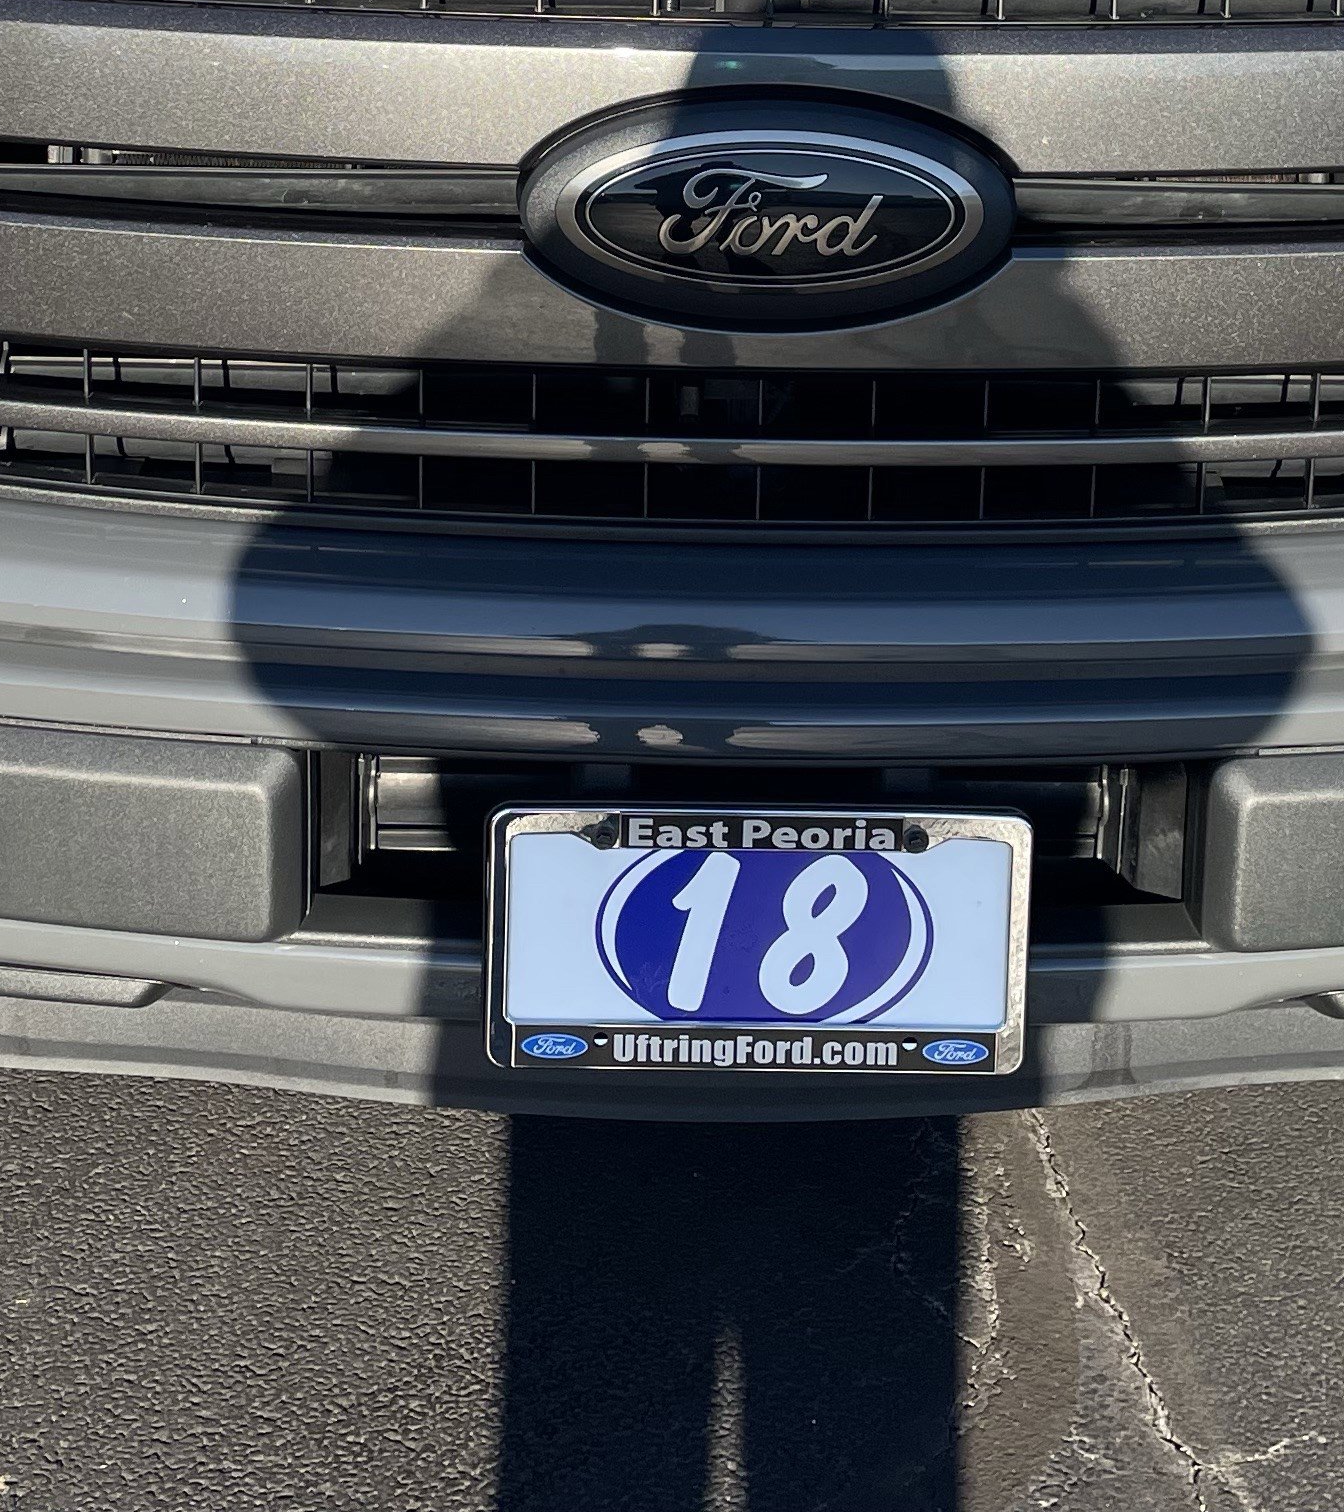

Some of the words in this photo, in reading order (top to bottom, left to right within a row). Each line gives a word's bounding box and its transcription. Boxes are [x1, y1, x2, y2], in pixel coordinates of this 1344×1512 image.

[658, 168, 884, 256] Ford
[628, 818, 729, 848] East
[742, 819, 895, 850] Peoria
[667, 852, 869, 1015] 18
[533, 1037, 577, 1055] Ford
[612, 1034, 898, 1067] UftringFord.com
[934, 1042, 978, 1062] Ford
